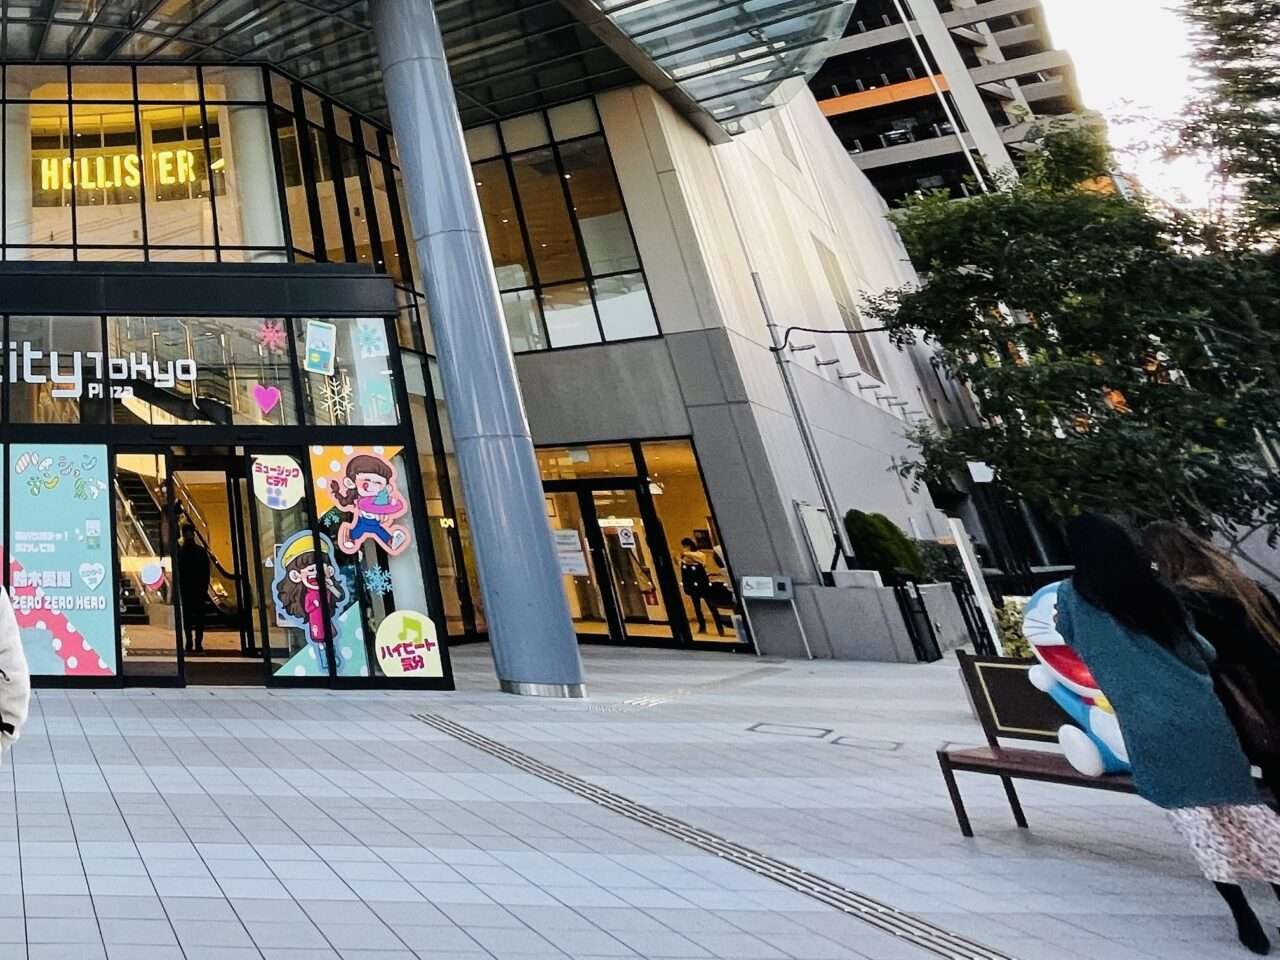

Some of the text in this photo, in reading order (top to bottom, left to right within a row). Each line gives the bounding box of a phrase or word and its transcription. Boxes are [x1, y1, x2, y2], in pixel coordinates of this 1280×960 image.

[41, 150, 196, 190] HOLLISER
[88, 383, 134, 399] Plza
[255, 462, 300, 478] ミュージック
[13, 595, 106, 610] ZERO ZERO HERO
